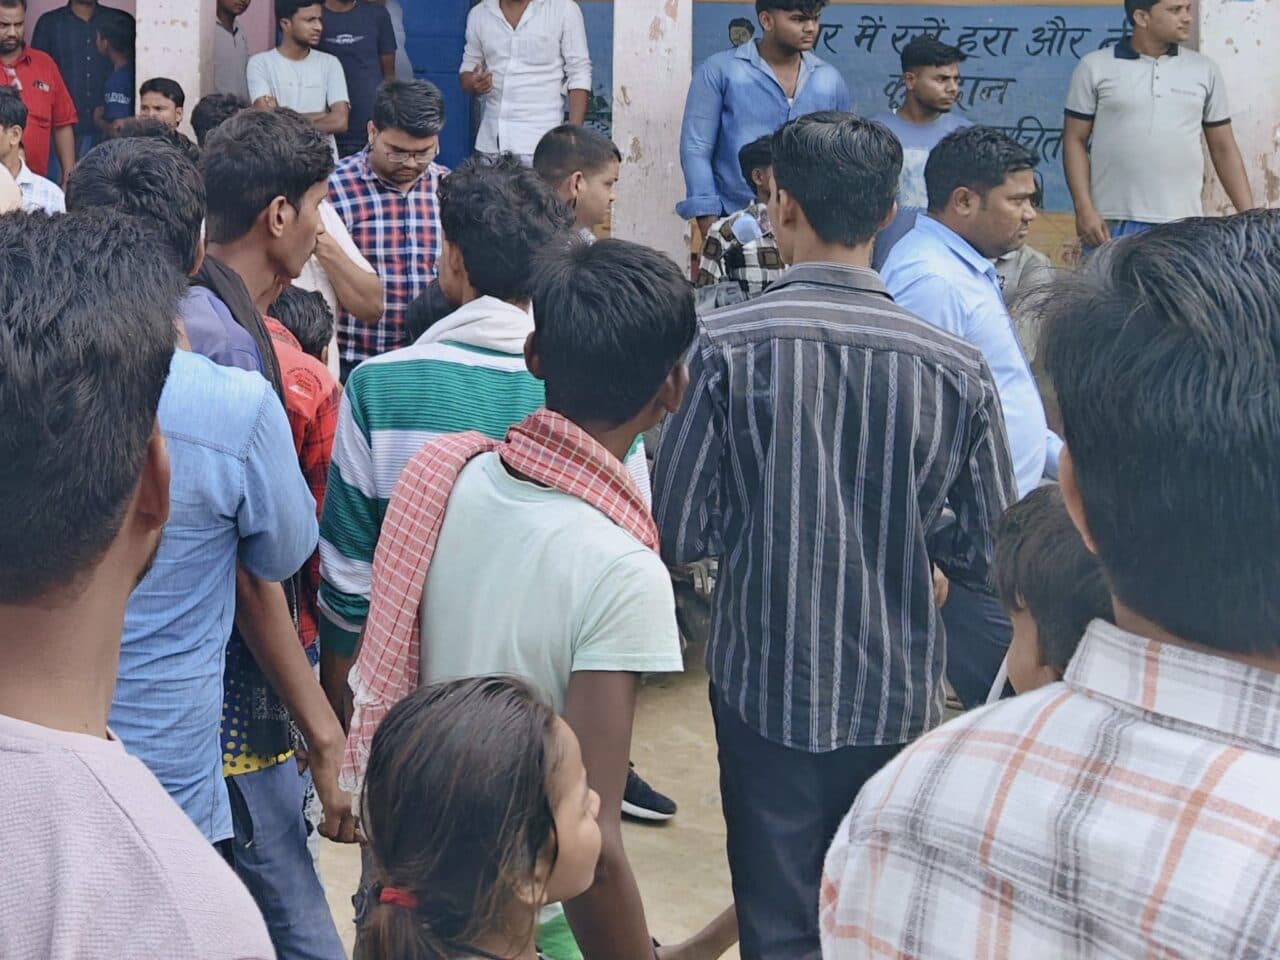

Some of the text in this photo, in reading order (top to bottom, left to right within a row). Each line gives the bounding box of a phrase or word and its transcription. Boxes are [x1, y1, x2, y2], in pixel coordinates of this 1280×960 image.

[854, 15, 887, 54] में
[958, 23, 1019, 57] हरा
[1025, 14, 1093, 58] और
